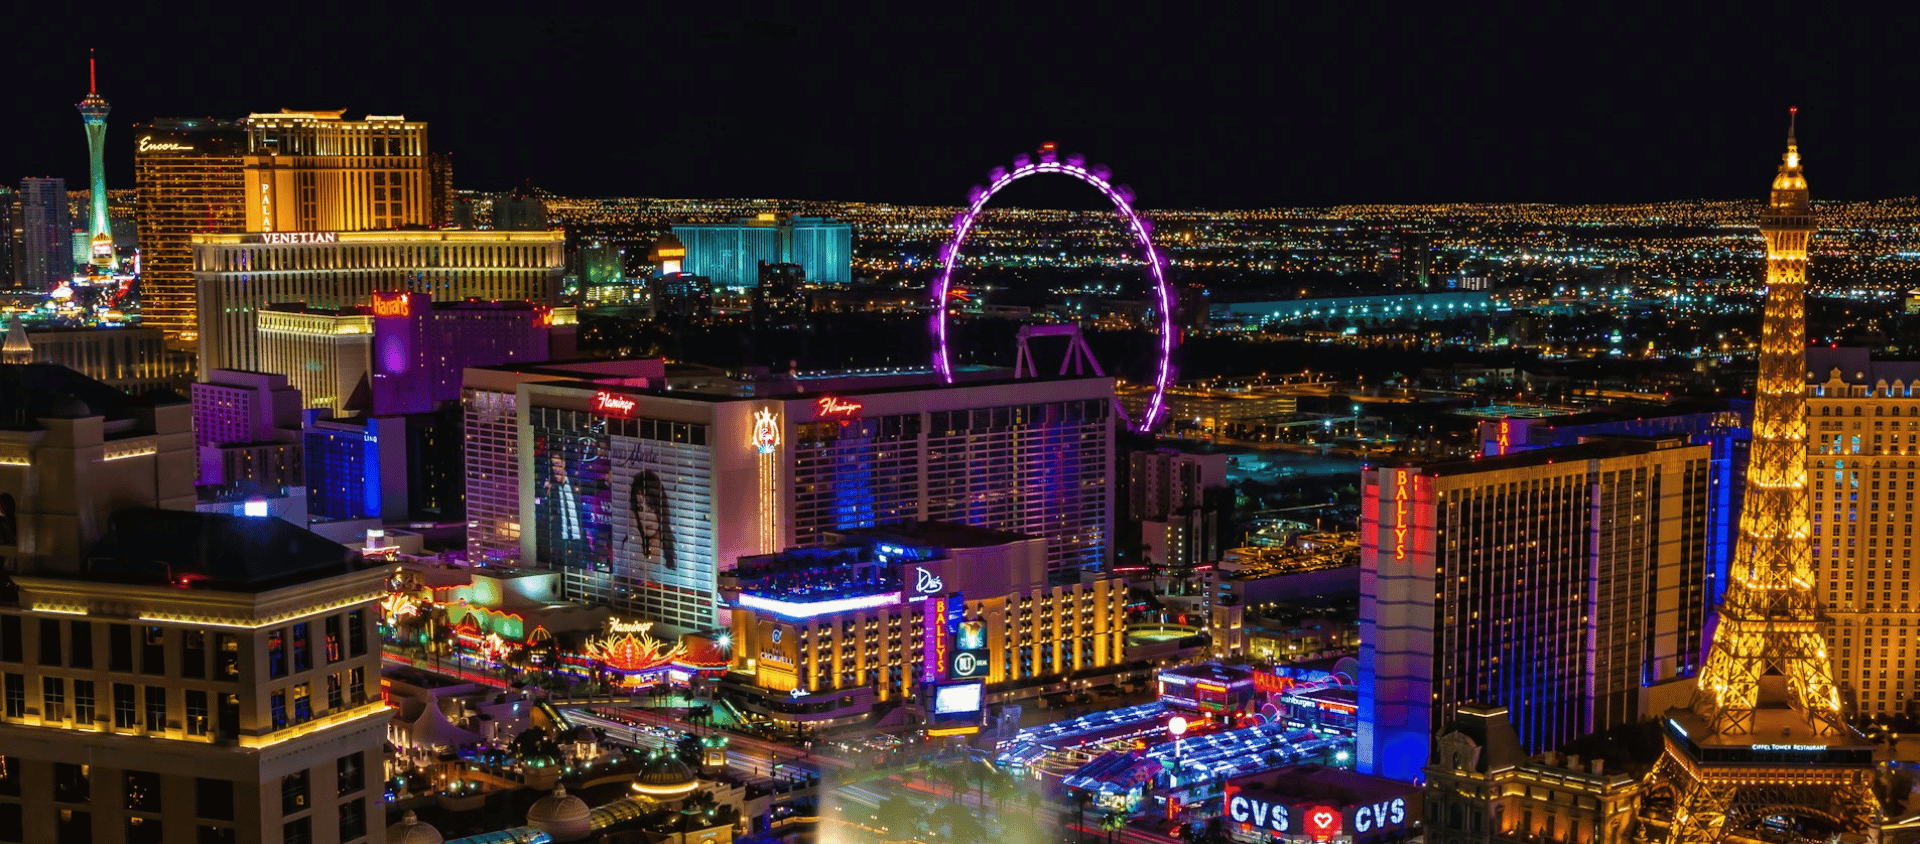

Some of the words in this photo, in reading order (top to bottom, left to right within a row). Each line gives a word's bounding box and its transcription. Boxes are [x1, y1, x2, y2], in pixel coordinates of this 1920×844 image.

[140, 136, 194, 152] Encore
[262, 232, 335, 244] VENETIAN
[598, 391, 635, 415] Flamingo
[819, 397, 862, 416] Flamingo
[1395, 471, 1408, 560] BALLYS
[609, 616, 654, 636] Flamingo
[936, 600, 946, 672] BALLYS
[760, 651, 794, 666] CROMWELL
[1230, 796, 1289, 832] CVS
[1355, 798, 1405, 832] CVS
